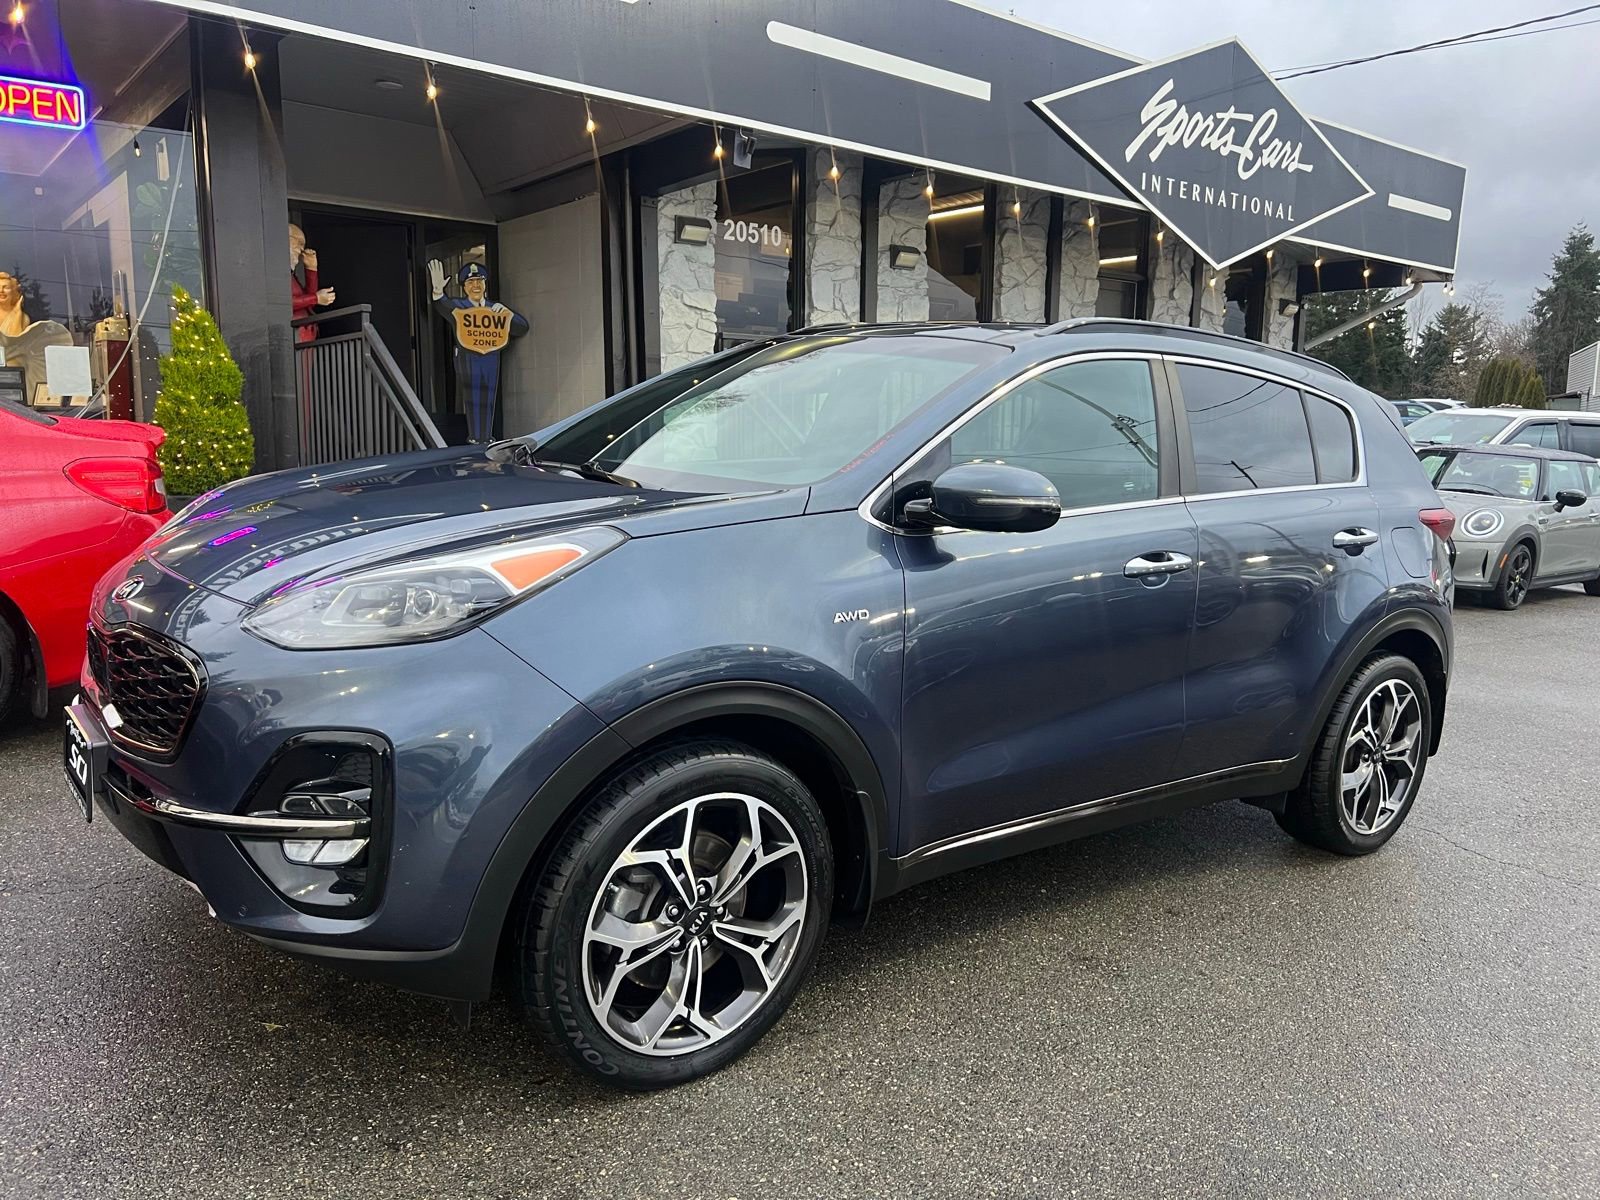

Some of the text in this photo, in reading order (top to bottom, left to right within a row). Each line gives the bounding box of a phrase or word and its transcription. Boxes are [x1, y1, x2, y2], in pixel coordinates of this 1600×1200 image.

[1125, 79, 1314, 181] Sports Cars
[1141, 172, 1295, 222] INTERNATIONAL
[723, 219, 782, 246] 20510
[463, 313, 507, 329] SLOW
[467, 329, 504, 339] SCHOOL
[473, 339, 498, 347] ZONE
[833, 609, 870, 624] AWD
[688, 911, 709, 934] KIA
